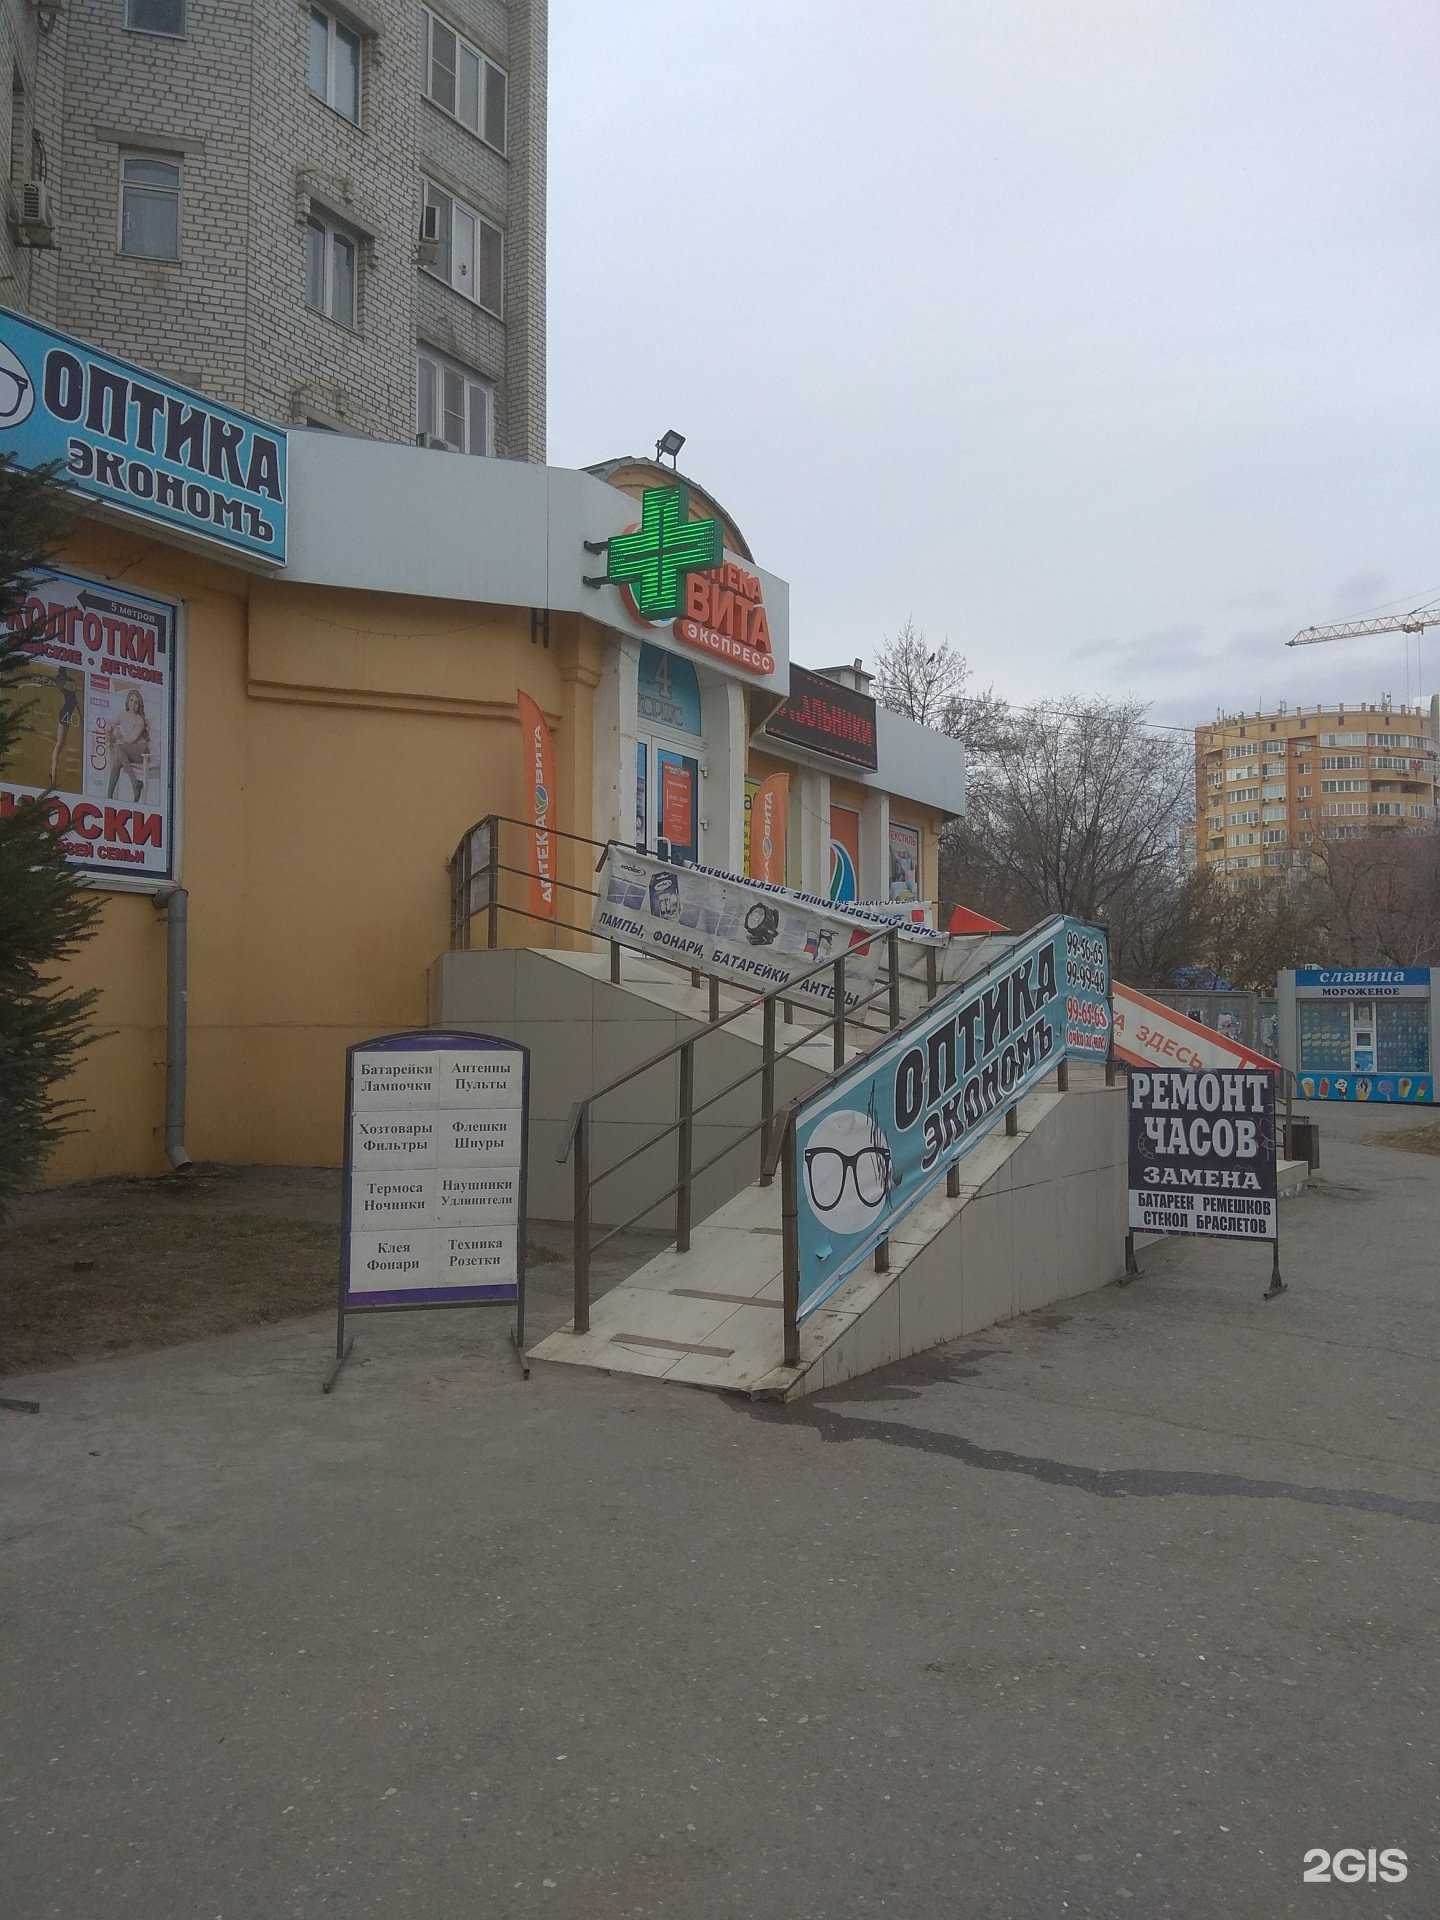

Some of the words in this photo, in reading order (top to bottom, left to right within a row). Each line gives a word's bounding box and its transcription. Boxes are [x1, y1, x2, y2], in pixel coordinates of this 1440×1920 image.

[43, 348, 283, 503] ОПТИКА
[67, 438, 274, 543] ЭКОНОМЪ
[111, 601, 118, 612] 5
[686, 573, 772, 653] ВИТА
[688, 623, 770, 670] ЭКСПРЕСС
[90, 717, 107, 770] Conte
[534, 725, 545, 783] ВИТА
[536, 814, 551, 903] АПТЕКА
[600, 912, 645, 939] ЛАМПЫ,
[653, 931, 704, 959] ФОНАРИ,
[800, 979, 859, 1005] АНТЕЫ
[1320, 971, 1404, 982] славица
[1322, 987, 1400, 996] МОРОЖЕНОЕ
[895, 941, 1058, 1132] ОПТИКА
[1136, 1026, 1204, 1072] ЗДЕСЬ
[361, 1064, 433, 1077] Батарейки
[452, 1063, 511, 1074] Антенны
[361, 1080, 432, 1092] Лампочки
[455, 1078, 507, 1091] Пульты
[921, 1018, 1053, 1171] ЭКОНОМЪ
[1131, 1073, 1268, 1112] РЕМОНТ
[359, 1123, 433, 1136] Хозтовары
[452, 1121, 507, 1133] Флешки
[1144, 1117, 1258, 1157] ЧАСОВ
[363, 1140, 428, 1152] Фильтры
[455, 1138, 504, 1150] Шнуры
[1143, 1166, 1261, 1190] ЗАМЕНА
[367, 1183, 423, 1196] Термоса
[442, 1180, 512, 1193] Наушники
[364, 1200, 425, 1211] Ночники
[441, 1196, 512, 1207] Удлинители
[1138, 1192, 1194, 1210] БАТАРЕЕК
[1202, 1197, 1271, 1216] РЕМЕШКОВ
[1144, 1211, 1188, 1228] СТЕКОЛ
[1196, 1215, 1267, 1234] БРАСЛЕТОВ
[378, 1242, 410, 1253] Клея
[449, 1239, 502, 1250] Техника
[367, 1259, 419, 1272] Фонари
[449, 1256, 500, 1267] Розетки
